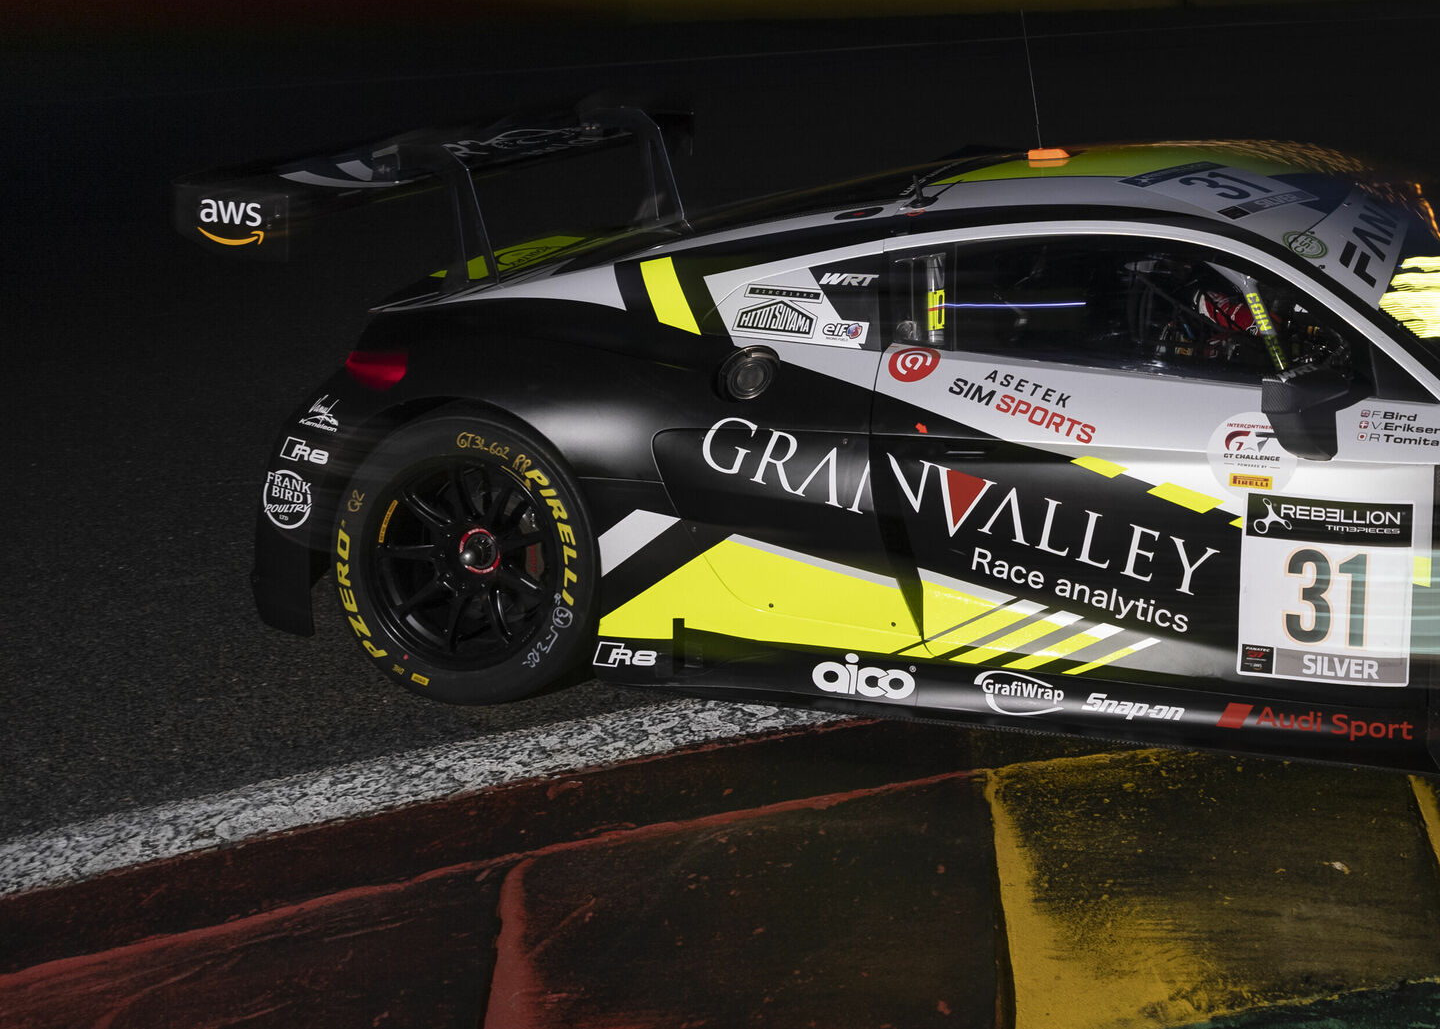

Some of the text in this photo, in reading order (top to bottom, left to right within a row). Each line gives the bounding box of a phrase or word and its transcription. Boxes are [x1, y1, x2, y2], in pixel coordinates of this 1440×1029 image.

[1178, 172, 1272, 200] 31
[200, 197, 262, 227] aws
[818, 273, 879, 287] WRT
[739, 303, 810, 333] HITOTSUYAMA
[1246, 292, 1272, 332] COIN
[823, 323, 848, 337] elf
[983, 369, 1073, 408] ASETEK
[299, 418, 338, 433] Kameleon
[948, 377, 1097, 445] SIM SPORTS
[1383, 434, 1440, 447] Tomita
[1235, 453, 1281, 462] CHALLENGE
[267, 471, 312, 494] FRANK
[271, 485, 304, 504] BIRD
[1232, 475, 1269, 488] PIRELLI
[264, 503, 313, 513] POULTRY
[701, 416, 1221, 597] GRANVALLEY
[525, 469, 577, 606] PIRELLI
[336, 528, 388, 658] P ZERO
[971, 547, 1190, 634] Race analytics
[1281, 546, 1372, 648] 31
[812, 653, 916, 700] aico
[1303, 654, 1379, 680] SILVER
[981, 676, 1065, 705] GrafiWrap
[1081, 692, 1186, 721] Snap-on
[1255, 706, 1414, 741] Audi Sport
